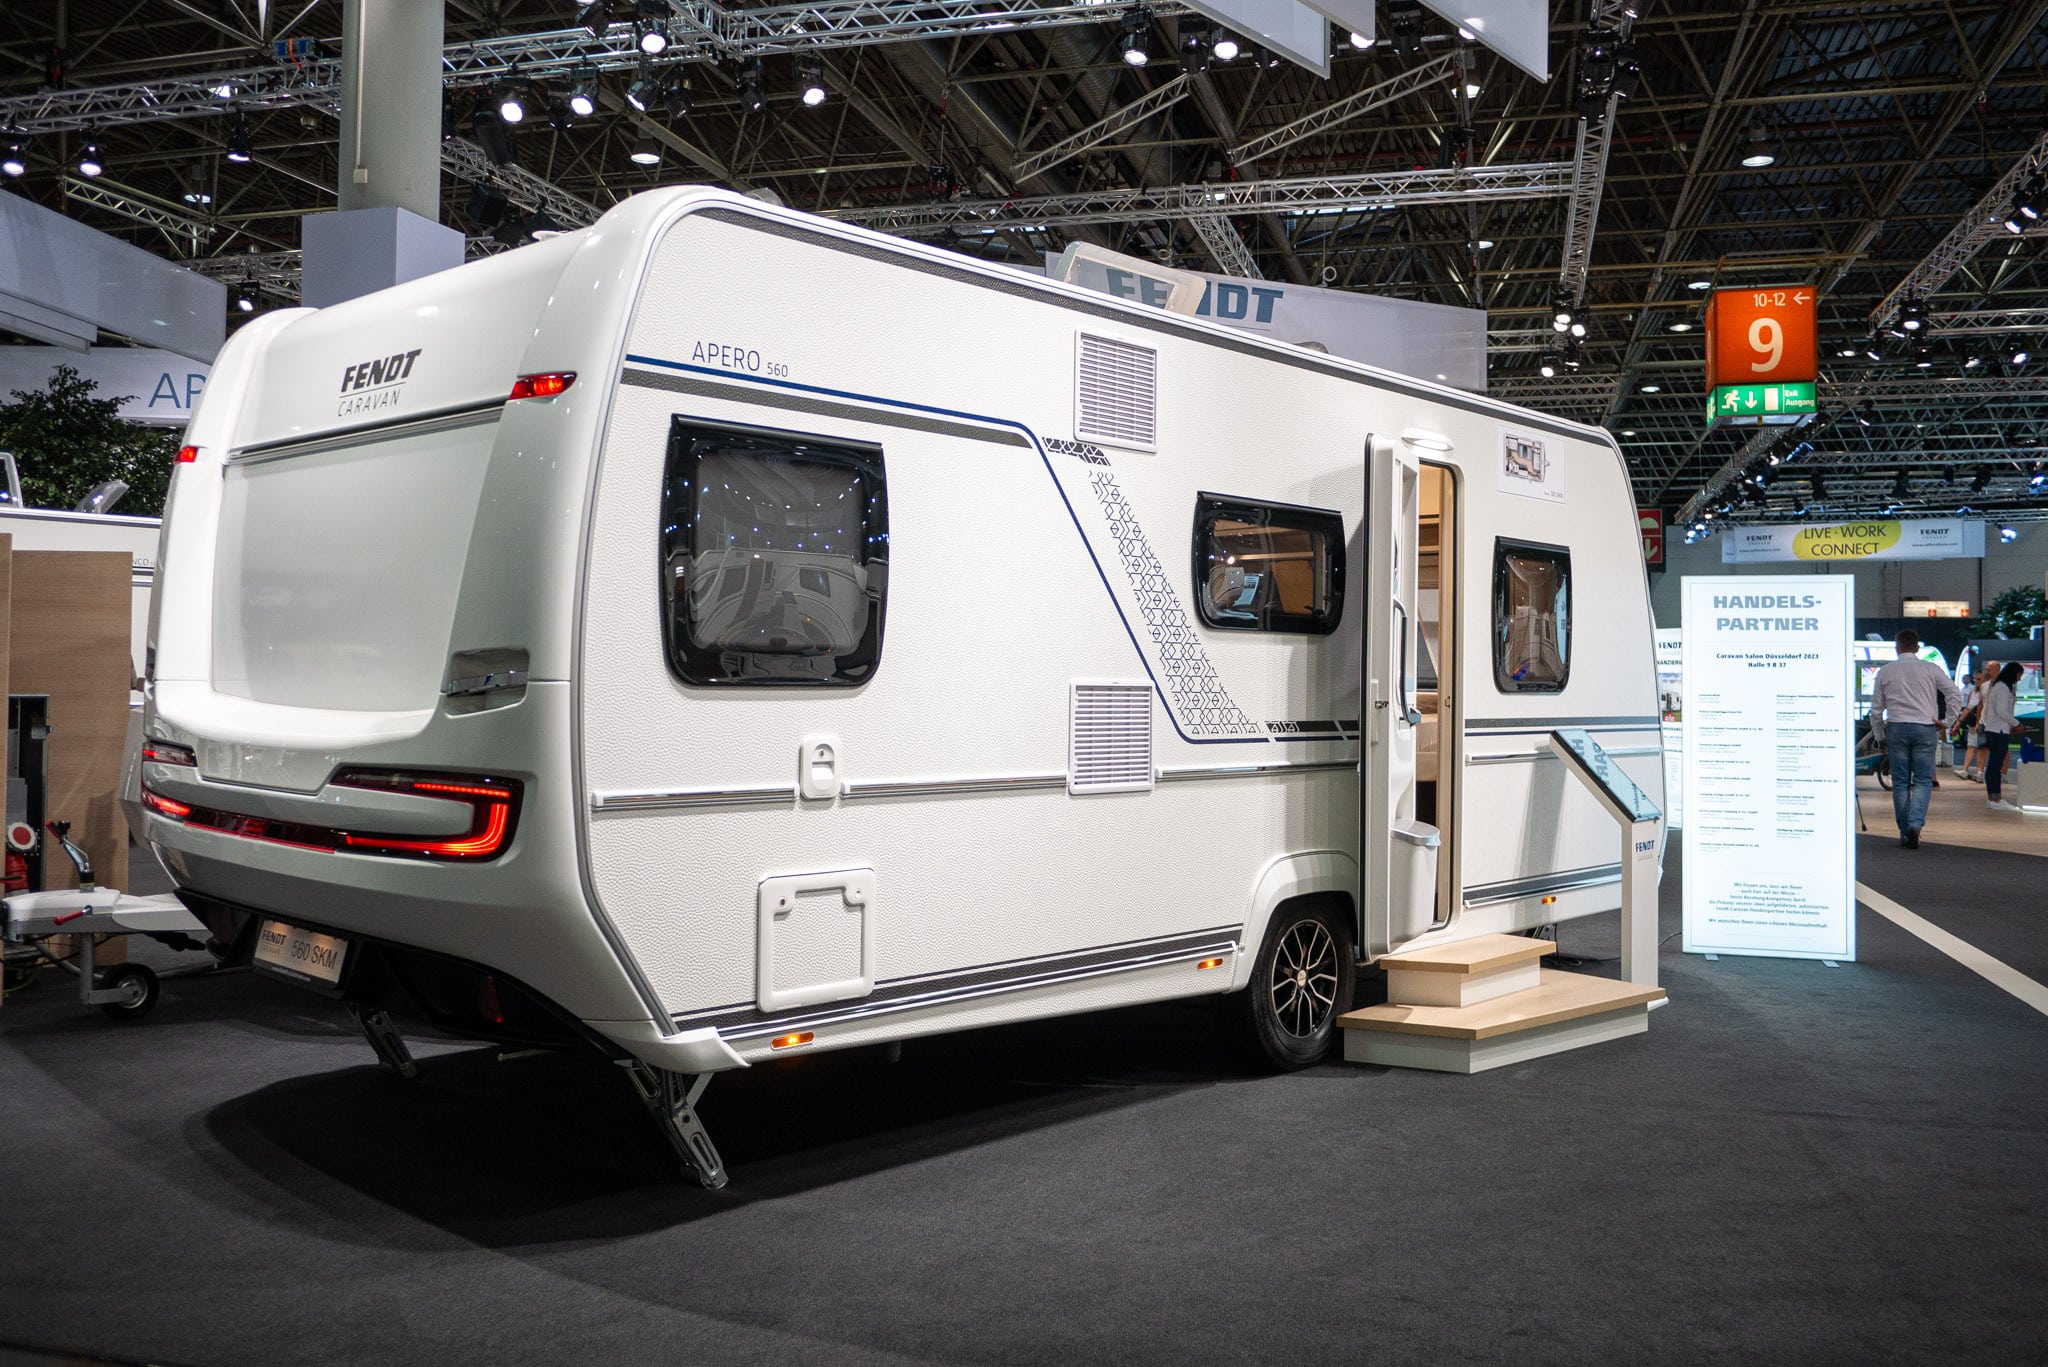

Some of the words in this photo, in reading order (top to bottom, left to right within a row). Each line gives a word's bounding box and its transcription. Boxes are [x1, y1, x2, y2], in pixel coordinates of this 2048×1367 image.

[1753, 292, 1787, 307] 10-12
[1748, 317, 1784, 373] 9
[692, 341, 761, 372] APERO
[767, 362, 789, 378] 560
[340, 348, 422, 393] FENDT
[1785, 389, 1799, 397] Exit
[338, 389, 400, 417] CARAVAN
[1785, 398, 1815, 408] Ausgang
[1804, 528, 1832, 540] LIVE
[1839, 524, 1886, 539] WORK
[1811, 543, 1880, 557] CONNECT
[1713, 595, 1822, 609] HANDELS-
[1716, 617, 1819, 631] PARTNER
[1635, 840, 1655, 853] FENDT
[262, 929, 287, 946] FENDT
[291, 940, 311, 961] 560
[311, 945, 338, 969] SKM
